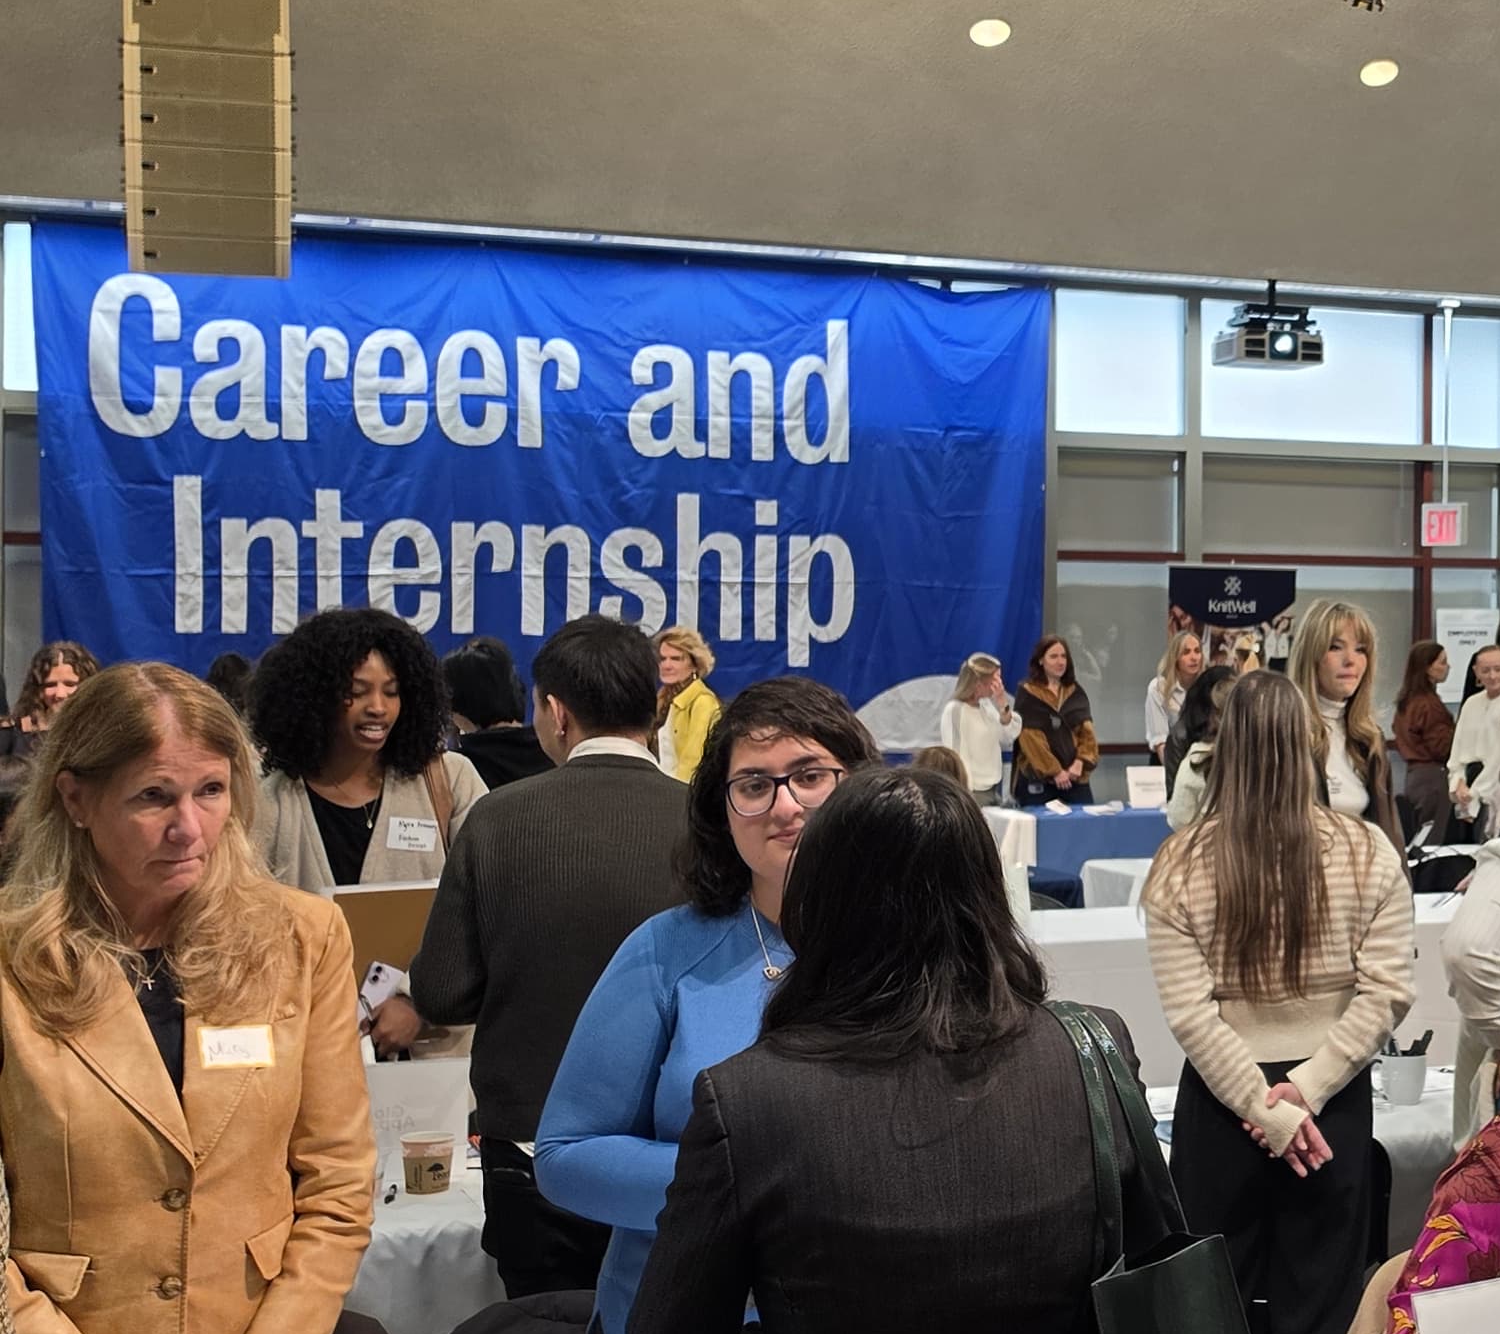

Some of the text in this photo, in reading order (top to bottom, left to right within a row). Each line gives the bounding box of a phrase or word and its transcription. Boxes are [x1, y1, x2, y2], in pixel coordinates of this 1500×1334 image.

[89, 273, 849, 463] Career and
[173, 475, 855, 667] Internship
[1208, 599, 1257, 614] KnitWell
